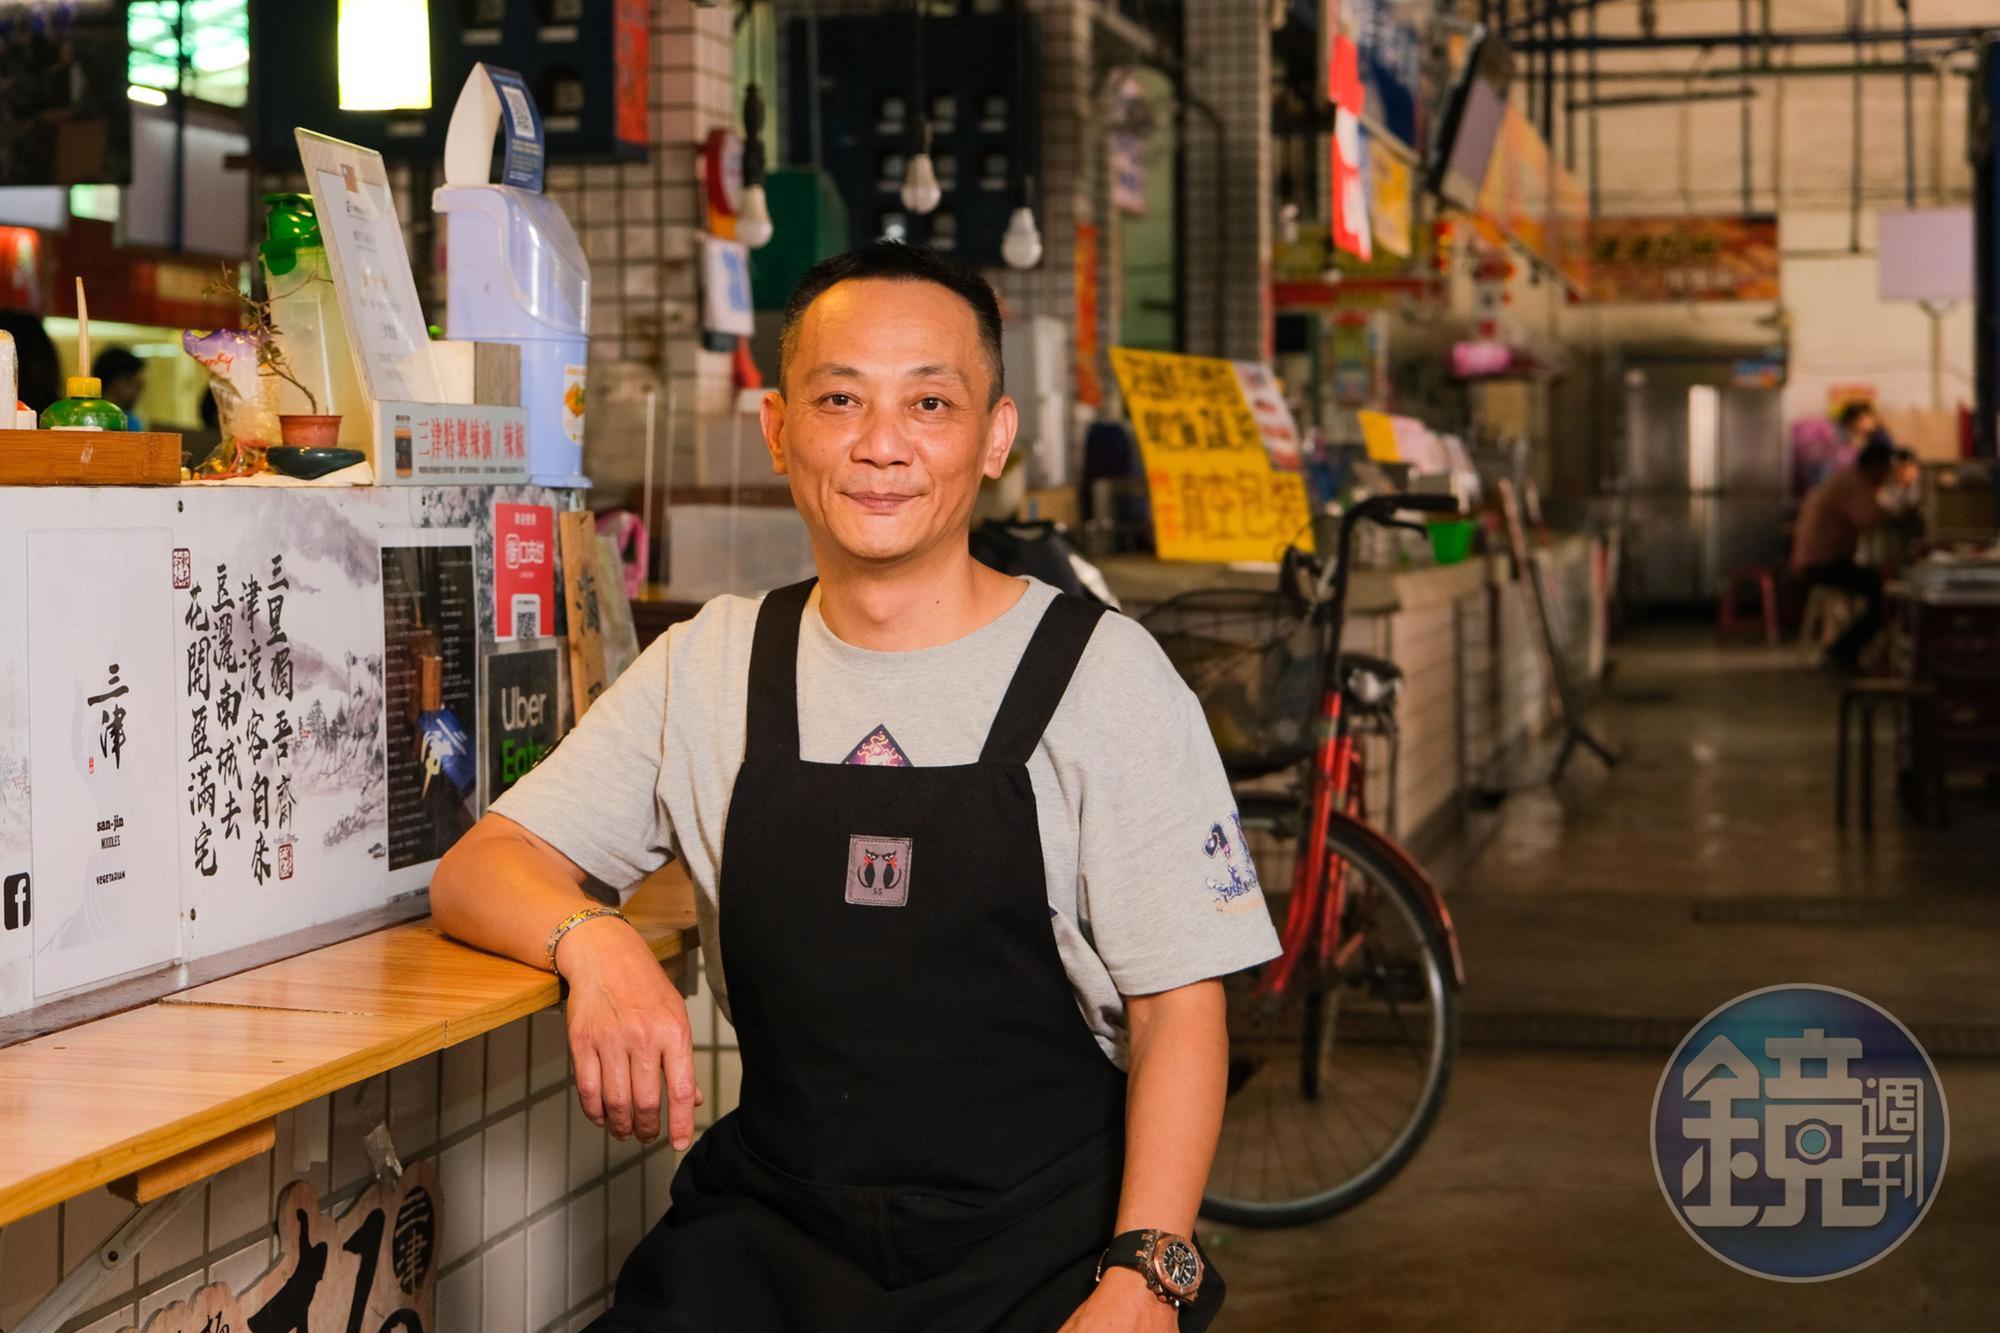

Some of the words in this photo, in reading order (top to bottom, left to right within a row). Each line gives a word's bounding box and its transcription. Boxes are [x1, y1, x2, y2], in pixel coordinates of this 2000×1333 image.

[88, 663, 129, 770] 三津
[502, 686, 547, 731] Uber
[96, 814, 124, 832] san-jin
[100, 835, 121, 850] NOODLES
[96, 869, 126, 885] VEGETARIAN
[396, 1190, 429, 1292] 三津
